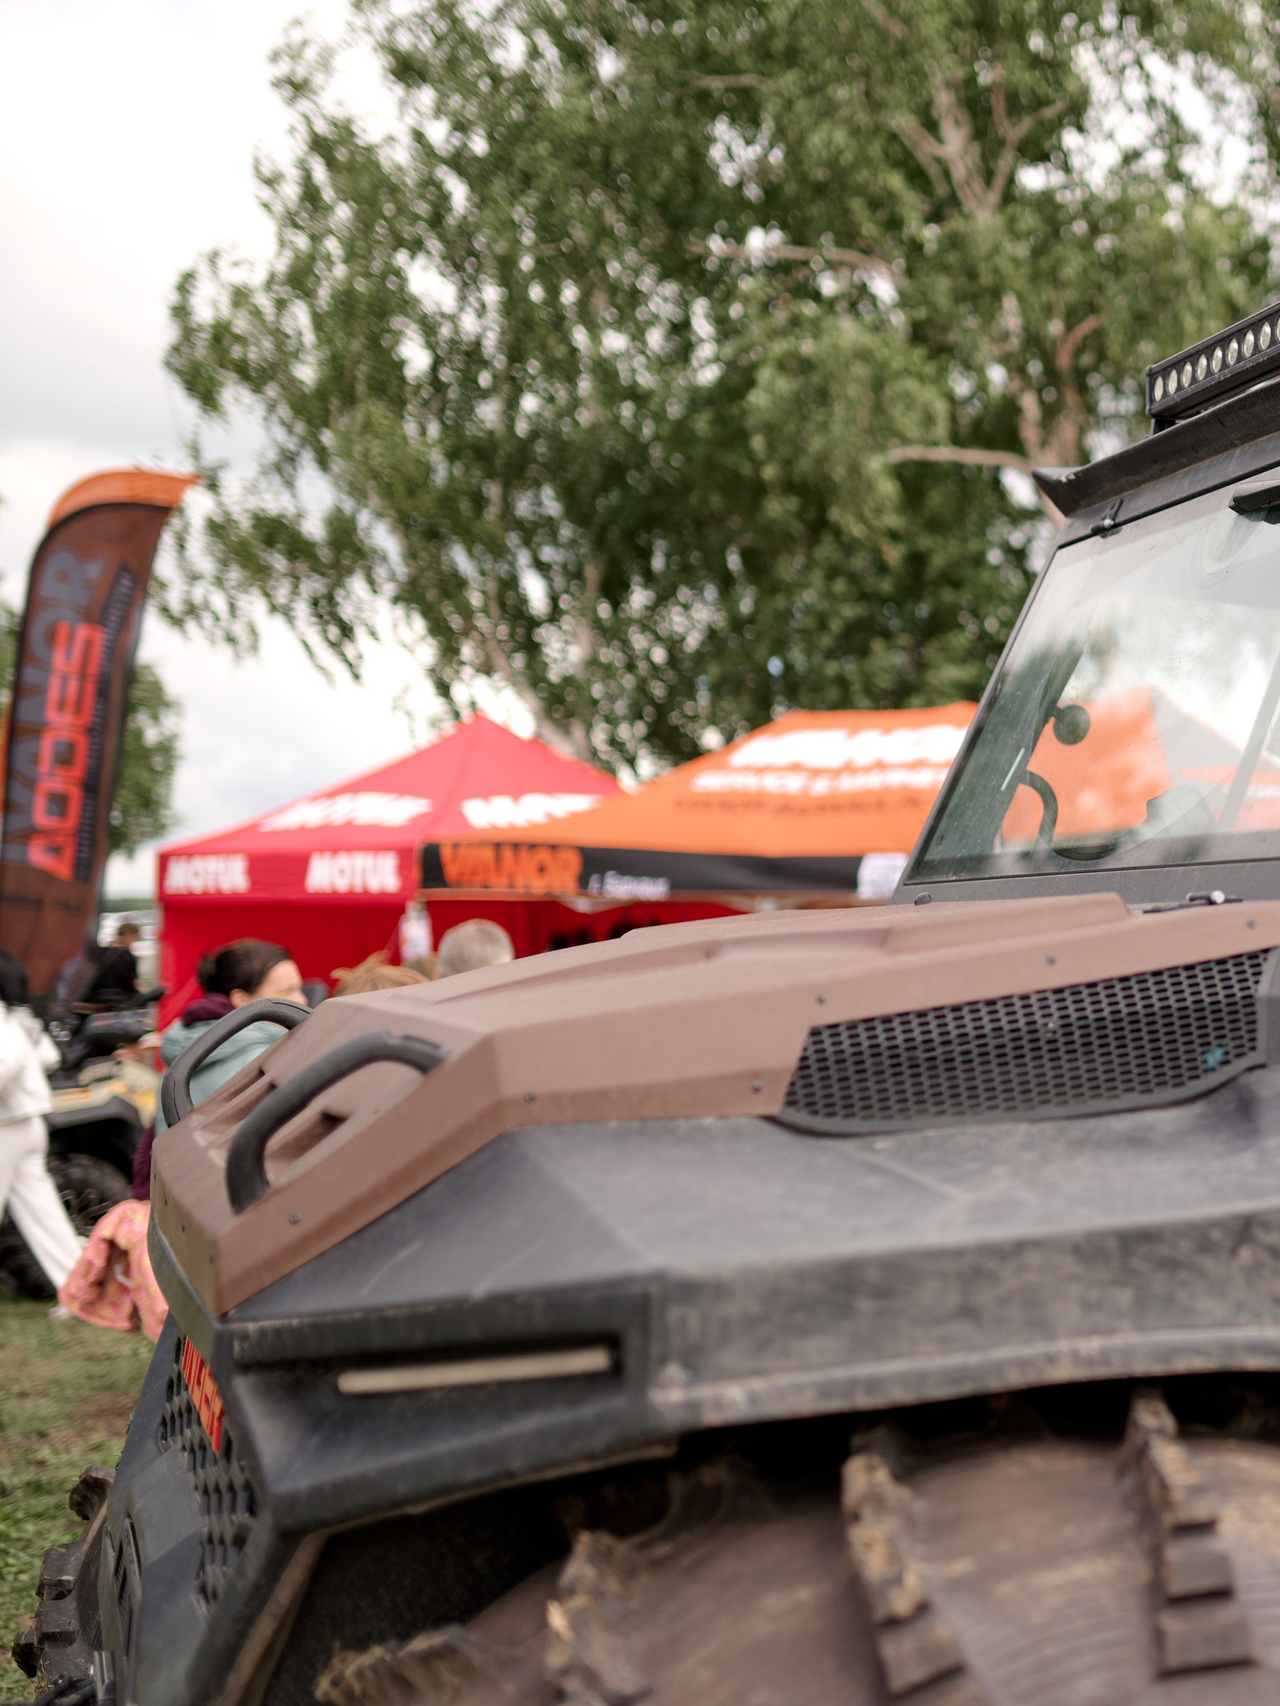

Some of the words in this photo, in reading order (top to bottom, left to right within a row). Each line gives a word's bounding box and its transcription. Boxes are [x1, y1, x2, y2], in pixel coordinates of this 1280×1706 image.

[26, 618, 106, 883] AODES
[163, 853, 250, 894] MOTUL
[304, 850, 402, 893] MOTUL
